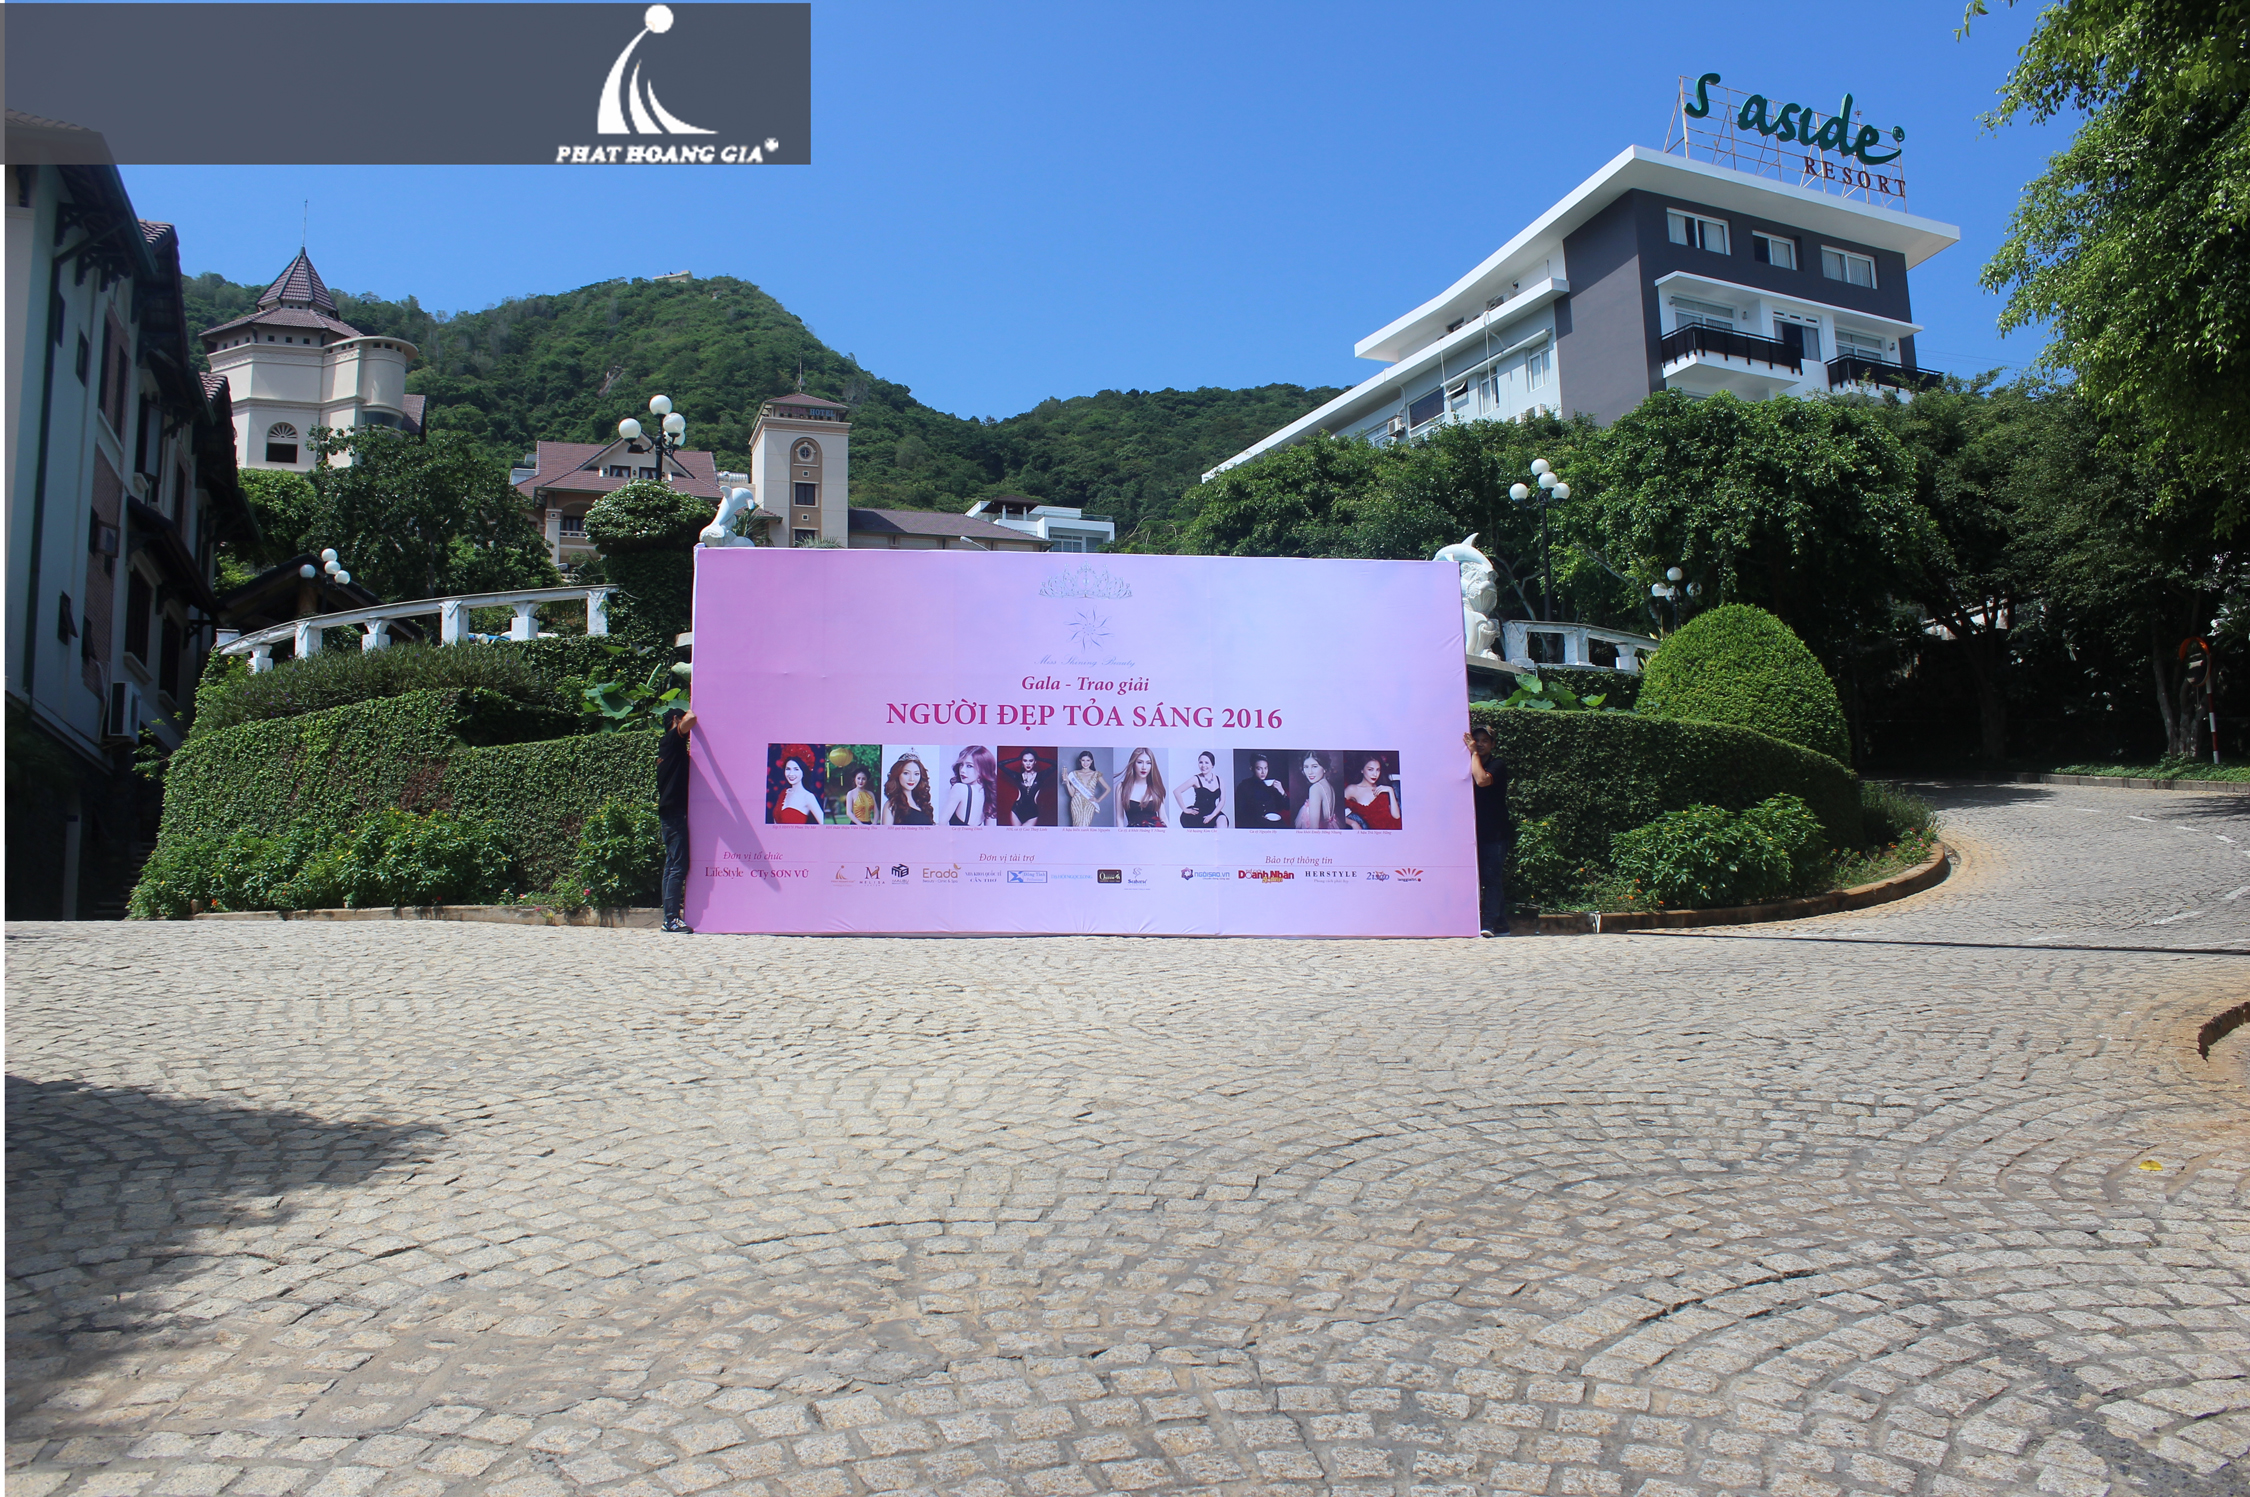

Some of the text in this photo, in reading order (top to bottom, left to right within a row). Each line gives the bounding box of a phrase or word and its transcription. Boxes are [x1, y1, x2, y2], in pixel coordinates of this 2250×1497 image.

[1803, 156, 1906, 199] RESORT
[809, 408, 836, 417] HOTEL
[1021, 675, 1061, 691] Gala
[1077, 676, 1115, 692] Trao
[1116, 676, 1150, 696] giải
[886, 697, 1283, 732] NGƯỜI ĐẸP TỎA SÁNG 2016
[723, 851, 742, 860] Đơn
[743, 851, 752, 862] vị
[979, 852, 1036, 864] Đơn vị tài trợ
[1296, 855, 1320, 867] thông
[1321, 856, 1333, 865] tin
[705, 866, 744, 880] LifeStyle
[750, 869, 769, 880] CTy
[770, 868, 792, 879] SƠN
[922, 867, 959, 879] Erada
[1304, 870, 1358, 879] HERSTYLE
